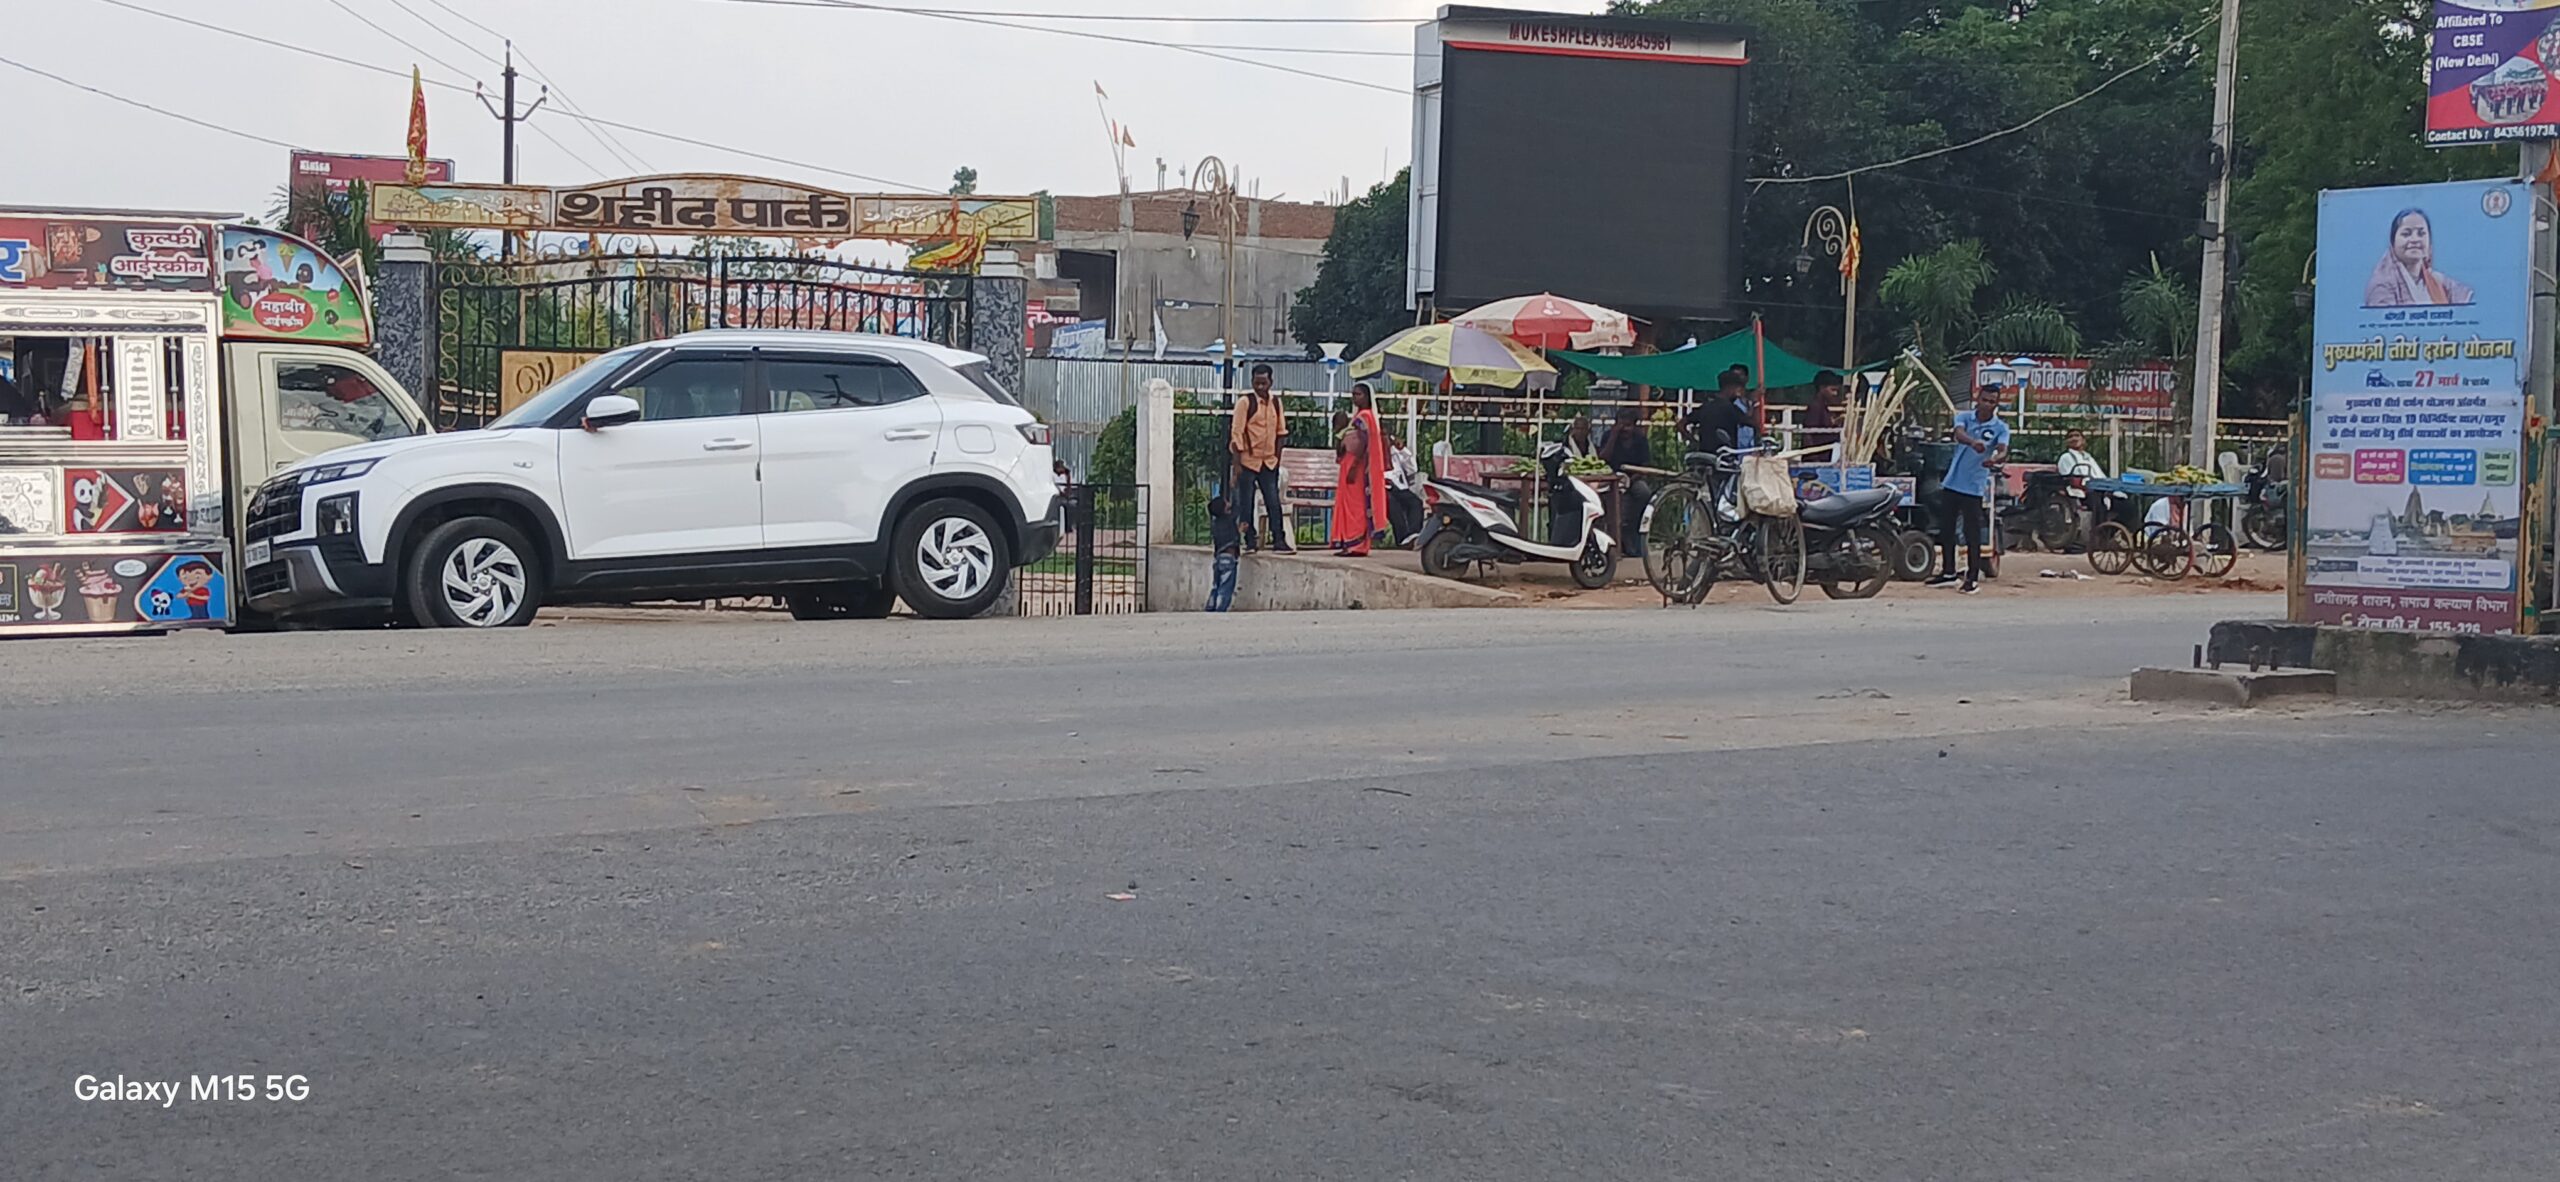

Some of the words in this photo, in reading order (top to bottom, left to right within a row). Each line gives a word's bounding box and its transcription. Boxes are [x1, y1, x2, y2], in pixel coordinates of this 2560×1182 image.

[2436, 13, 2486, 28] Affiliated
[2489, 13, 2503, 26] To
[1509, 23, 1599, 46] MUKESHFLEX
[2453, 34, 2484, 47] CBSE
[2435, 57, 2464, 71] (New
[2467, 53, 2499, 67] Delhi)
[2428, 130, 2467, 142] Contact
[2469, 128, 2483, 140] Us
[558, 187, 718, 228] शहीद
[726, 194, 850, 229] पार्क
[130, 226, 198, 249] कुल्फी
[114, 254, 207, 279] आईस्क्रीम
[261, 299, 306, 314] महावीर
[2324, 335, 2384, 371] मुख्यमंत्री
[2388, 334, 2420, 361] तीर्थ
[2423, 335, 2459, 363] दर्शन
[2464, 334, 2514, 359] योजना
[2415, 370, 2434, 388] 27
[2438, 374, 2459, 387] मार्च
[2314, 590, 2358, 606] छत्तीसगढ़
[2400, 596, 2430, 609] समाज
[2433, 598, 2473, 611] कल्याण
[2476, 596, 2508, 613] विभाग
